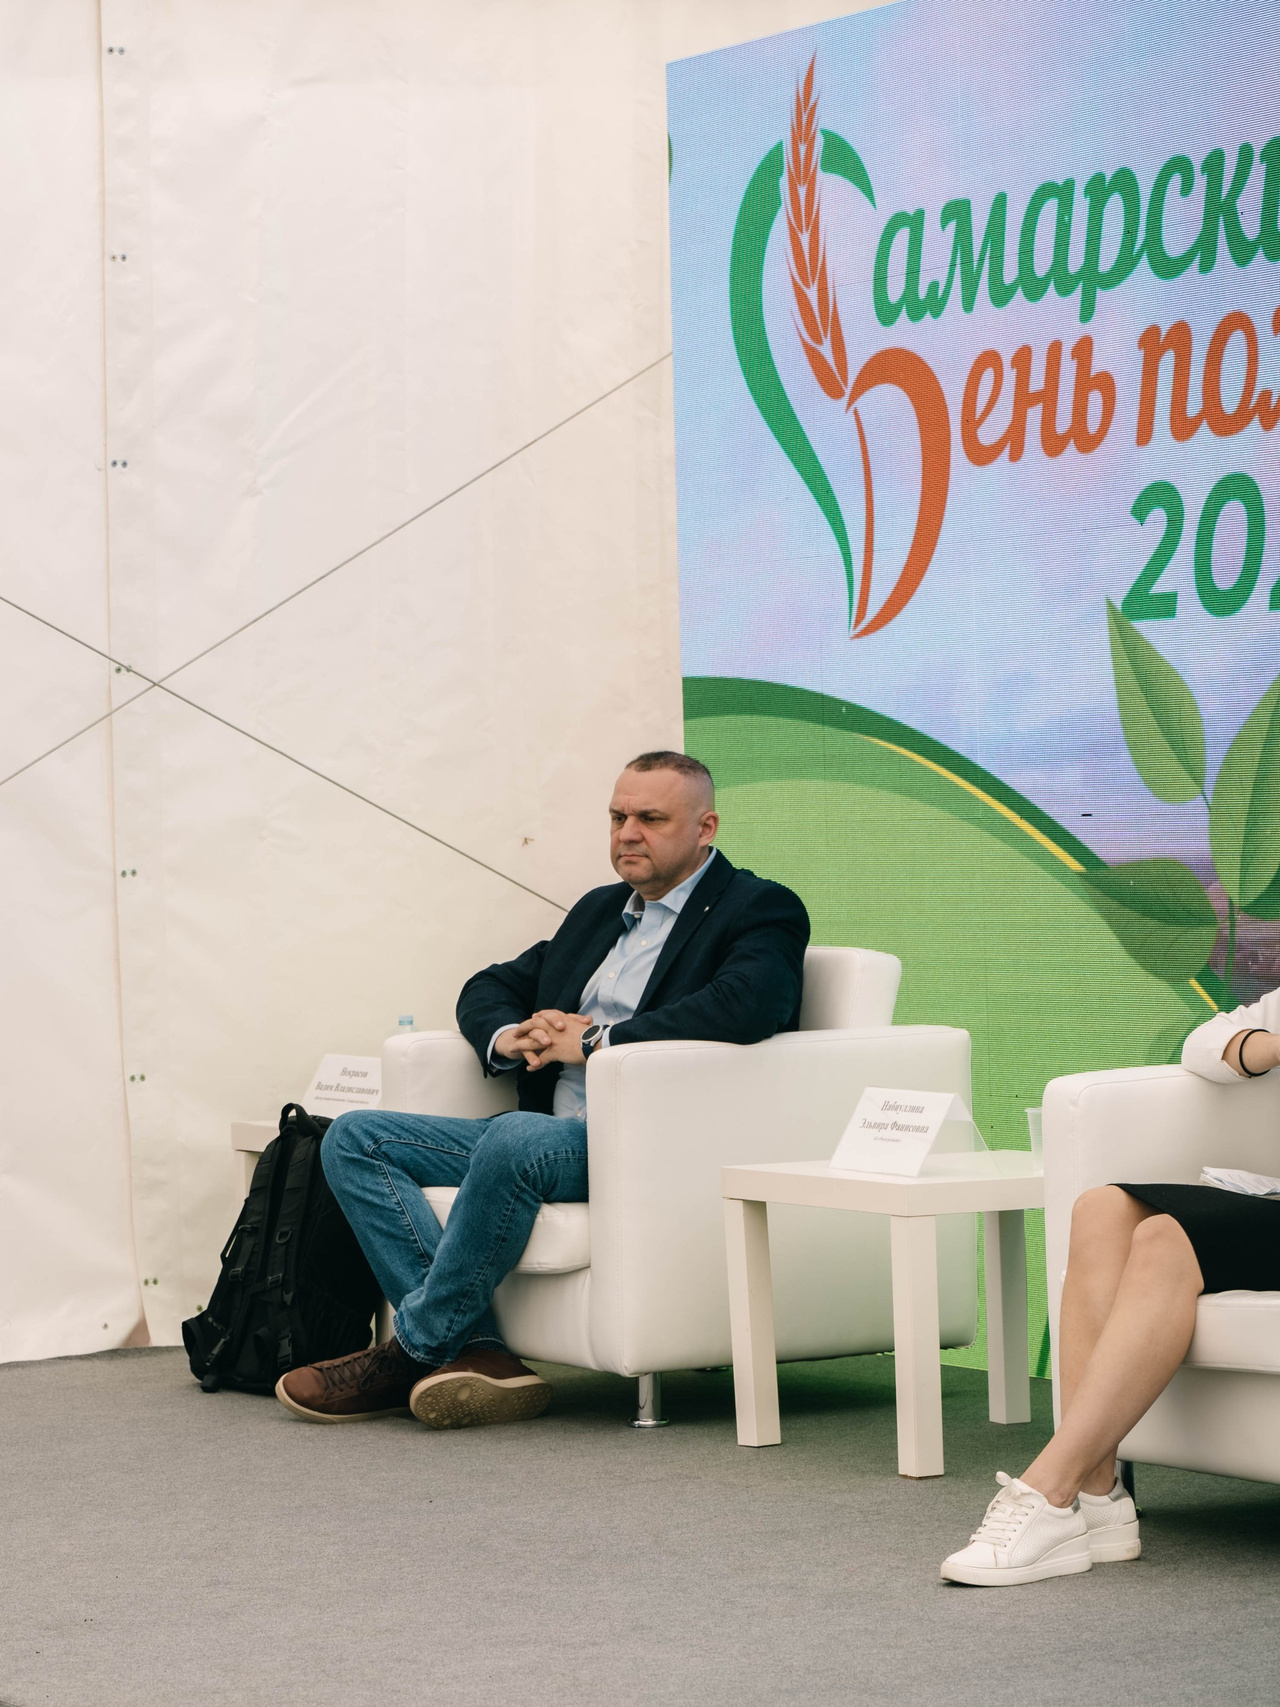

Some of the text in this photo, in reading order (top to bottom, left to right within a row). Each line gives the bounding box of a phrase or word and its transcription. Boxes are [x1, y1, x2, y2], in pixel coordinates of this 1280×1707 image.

[1136, 305, 1280, 447] по
[1121, 472, 1280, 621] 20
[859, 1118, 889, 1132] Эльвира
[881, 1100, 925, 1115] Набиуллина
